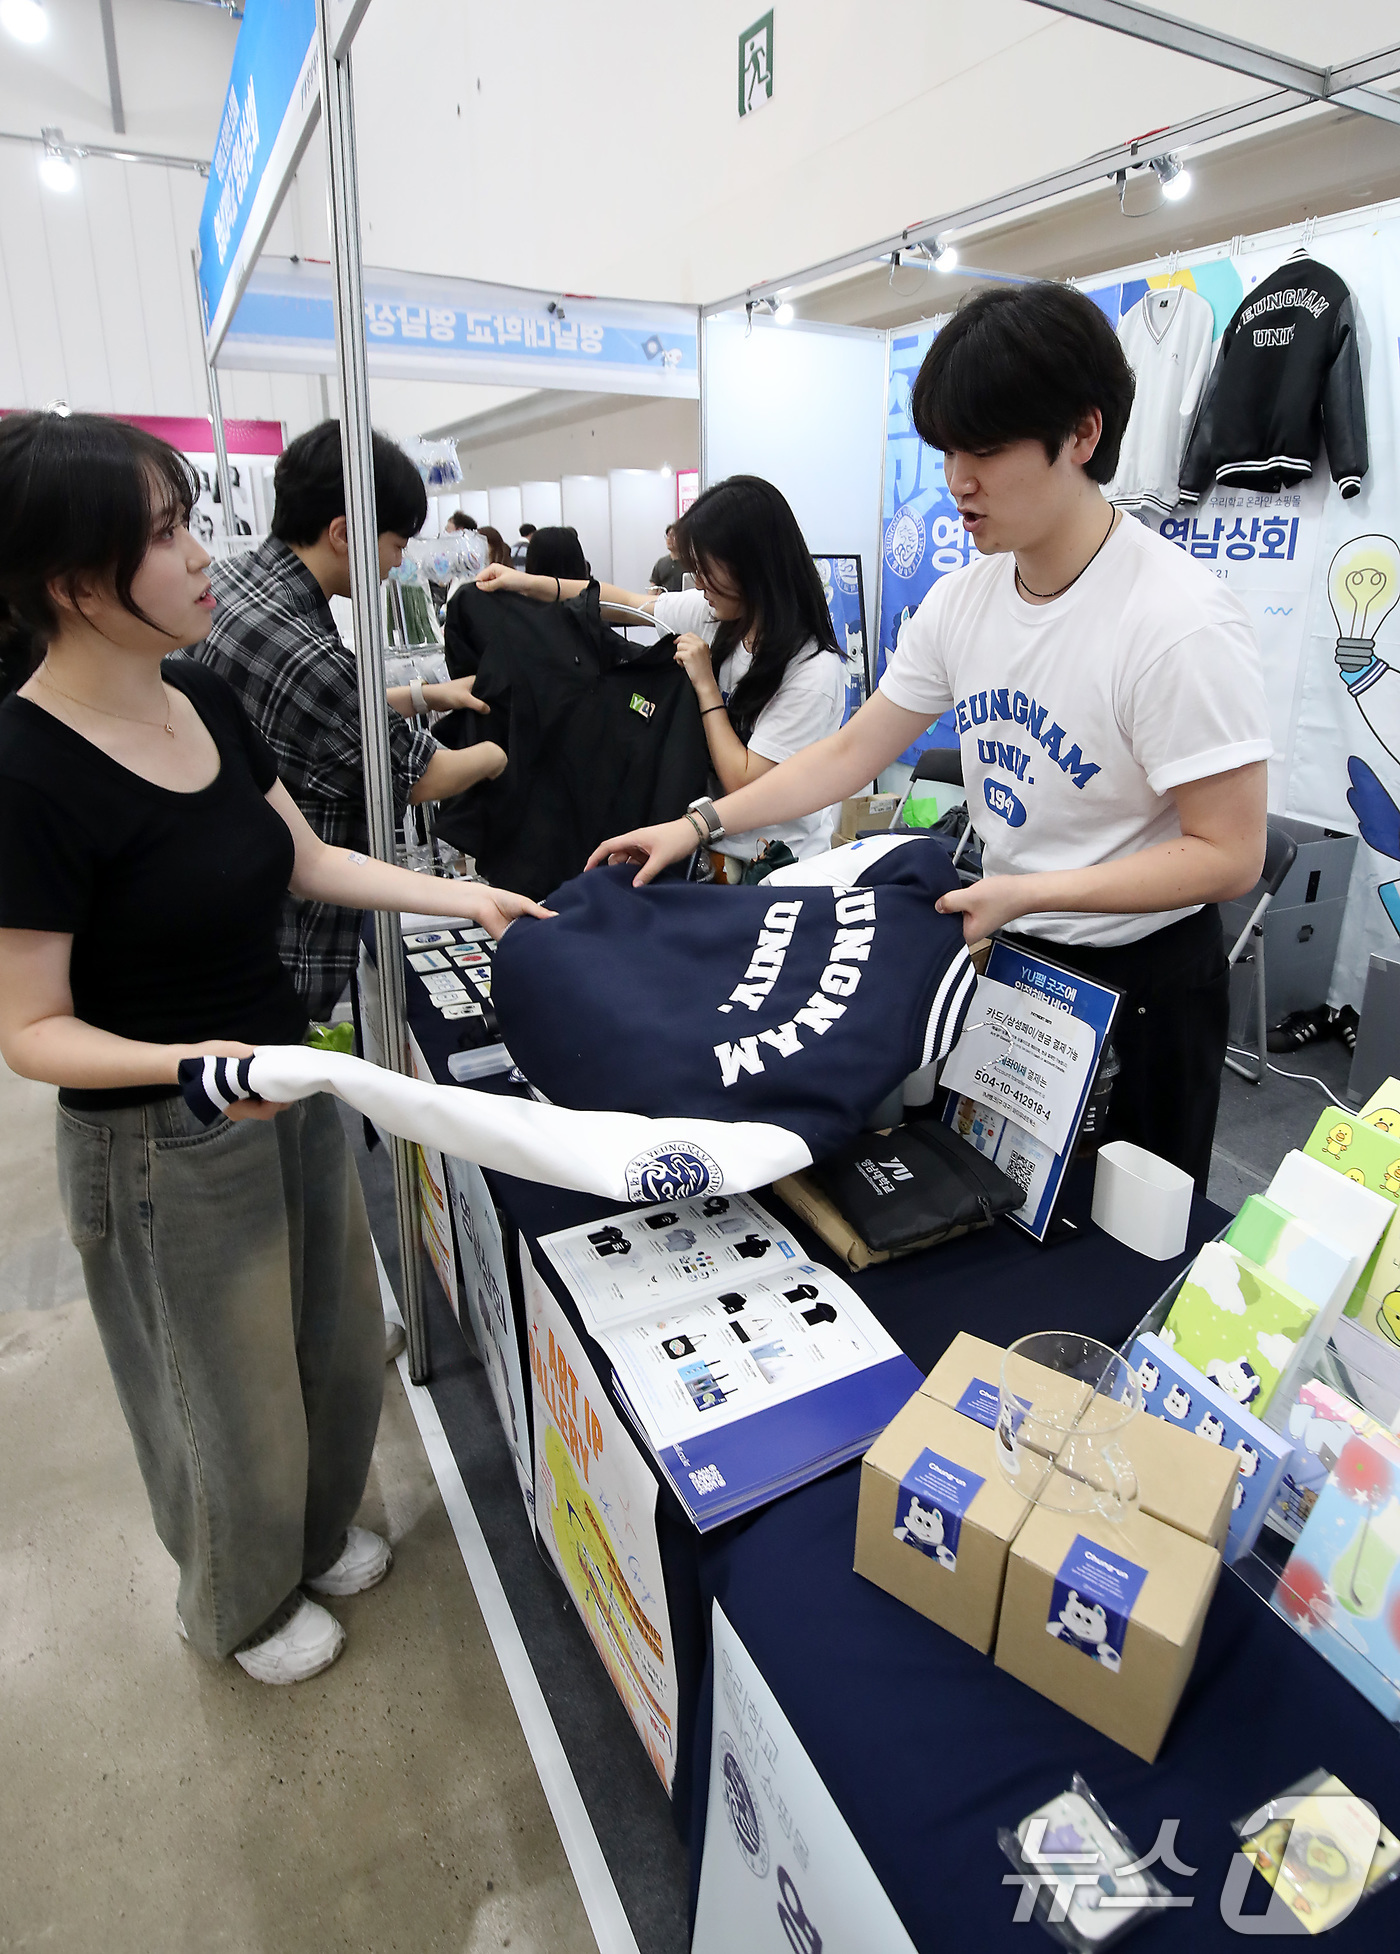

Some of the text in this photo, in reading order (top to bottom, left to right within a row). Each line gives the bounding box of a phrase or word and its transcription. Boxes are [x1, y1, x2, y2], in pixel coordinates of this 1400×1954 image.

[1236, 288, 1329, 334] EUNGNAM
[1209, 495, 1301, 508] 우리학교 온라인 쇼핑몰
[1160, 516, 1300, 561] 영남상회
[1208, 569, 1229, 579] 21
[716, 900, 804, 1014] UNIV.
[1045, 977, 1078, 1002] 굿즈에
[1053, 1038, 1067, 1055] 결제
[1067, 1047, 1079, 1062] 가능
[974, 1070, 1052, 1121] 504-10-412918-4
[646, 1143, 710, 1163] YEUNGNAM
[860, 1158, 896, 1194] 영남대학교
[528, 1329, 589, 1485] GALLERY
[548, 1328, 604, 1462] ART IP
[722, 1649, 779, 1775] 우리학교
